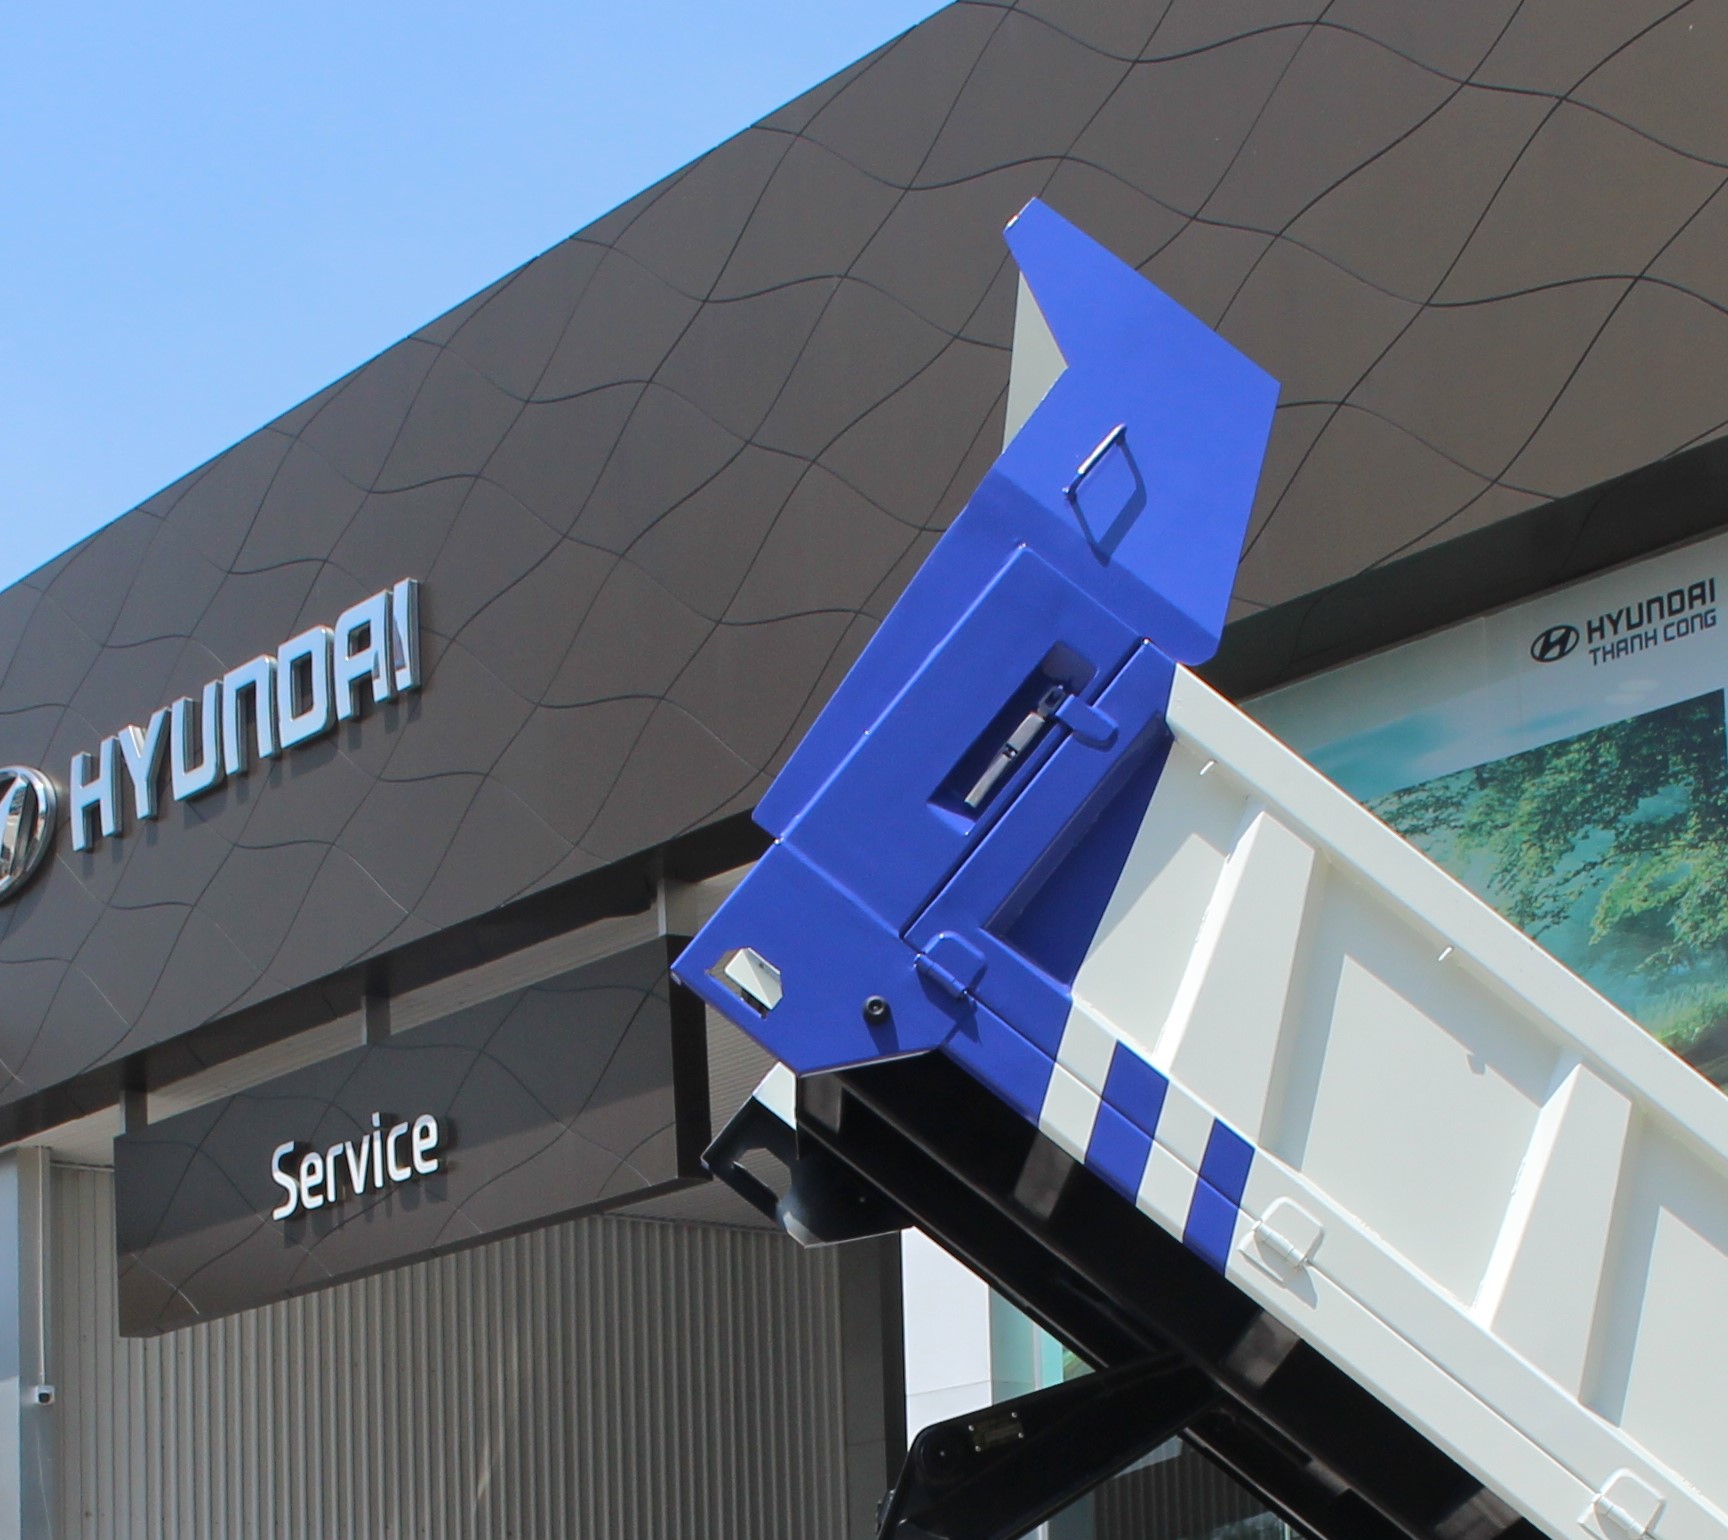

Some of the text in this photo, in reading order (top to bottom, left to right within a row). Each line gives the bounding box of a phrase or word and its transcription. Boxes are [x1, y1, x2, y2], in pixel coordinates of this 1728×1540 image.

[1587, 577, 1715, 644] HYUNDAI
[1589, 608, 1717, 666] THANH CONG
[71, 576, 422, 853] HYUNDAI
[272, 1111, 440, 1221] Service
